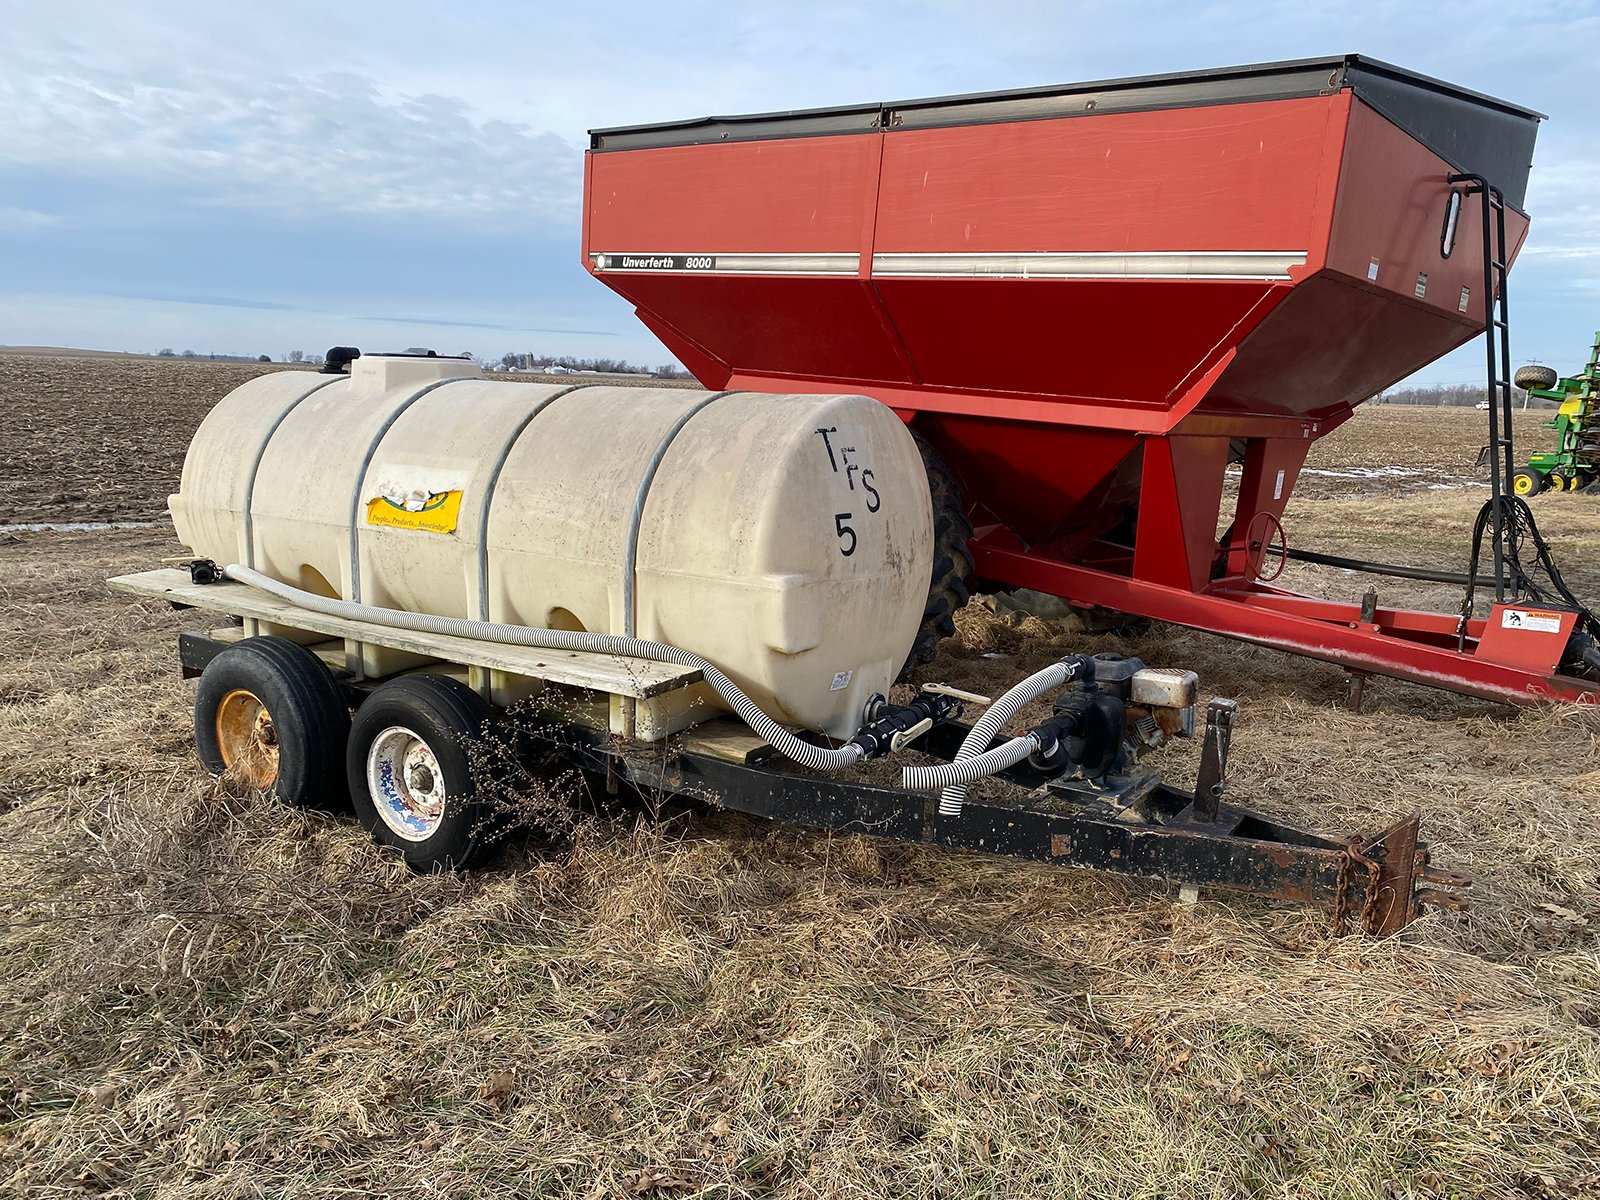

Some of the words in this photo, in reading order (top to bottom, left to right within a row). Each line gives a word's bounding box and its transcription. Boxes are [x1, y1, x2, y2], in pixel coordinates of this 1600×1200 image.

[622, 256, 674, 268] Unverferth
[685, 257, 712, 269] 8000
[835, 513, 857, 556] 5
